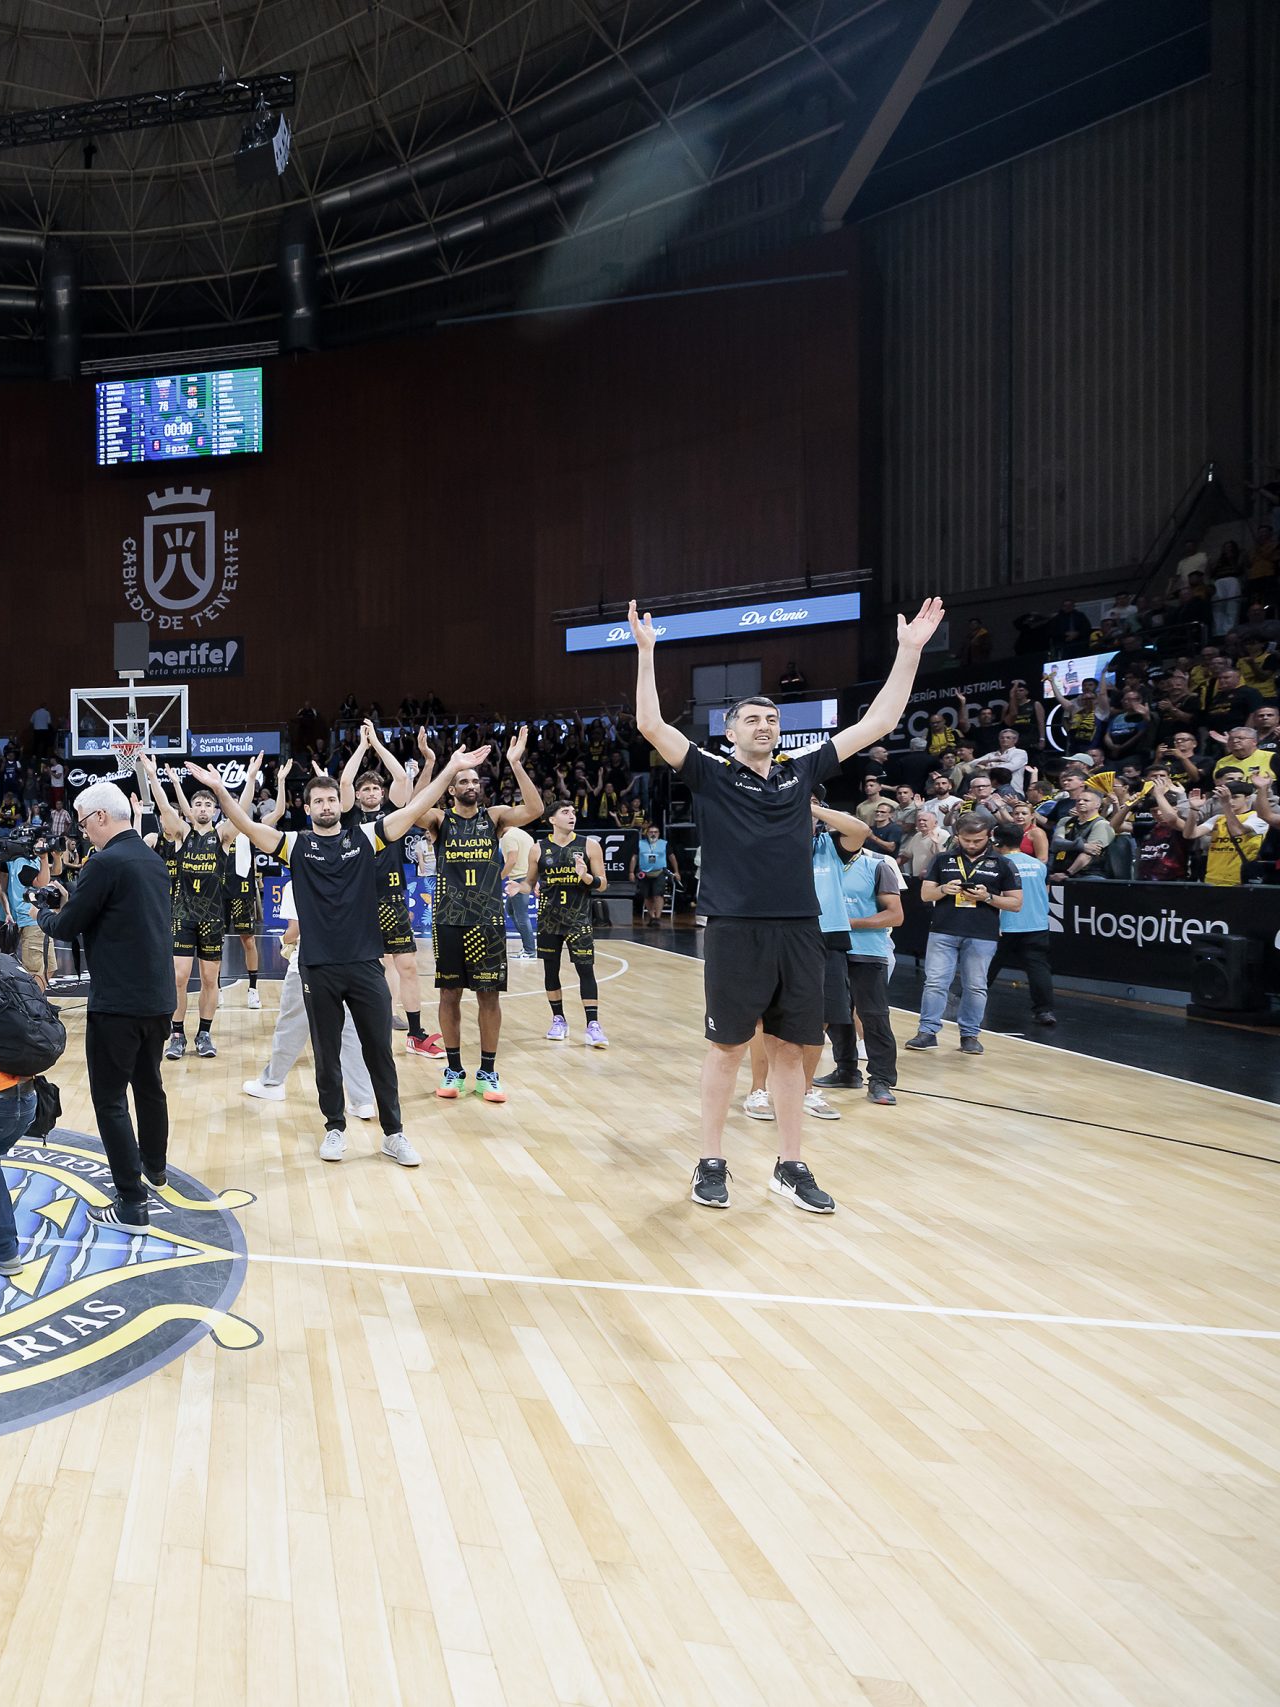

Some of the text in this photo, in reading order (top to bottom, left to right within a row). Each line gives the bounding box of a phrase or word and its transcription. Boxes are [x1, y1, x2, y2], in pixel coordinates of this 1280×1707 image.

[164, 422, 193, 437] 00:00
[122, 528, 239, 630] CABILDO DE TENERIFE
[739, 608, 809, 626] Da Canio
[606, 628, 630, 642] Da
[149, 640, 238, 671] nerife!
[200, 737, 244, 745] Ayuntamiento
[200, 742, 254, 753] Santa Úrsula
[445, 838, 492, 847] LA LAGUNA
[465, 869, 477, 886] 11
[193, 879, 200, 892] 4
[241, 882, 249, 893] 15
[560, 891, 567, 904] 3
